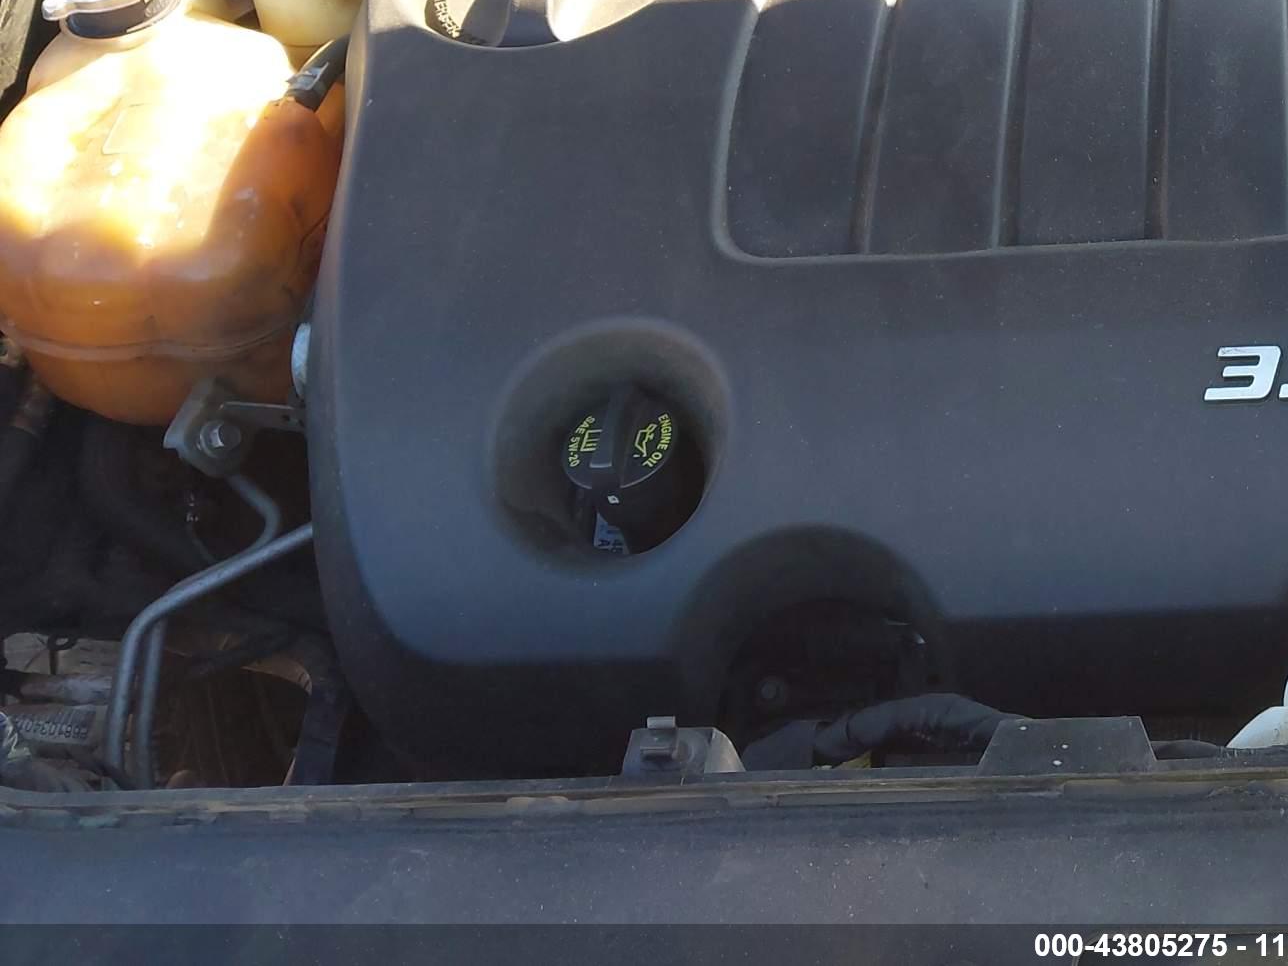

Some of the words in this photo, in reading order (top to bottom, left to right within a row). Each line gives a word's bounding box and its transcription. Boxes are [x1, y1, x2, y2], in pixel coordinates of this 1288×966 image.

[574, 415, 596, 435] SAE
[658, 413, 672, 450] ENGINE
[568, 436, 580, 467] 5W-20
[642, 451, 663, 468] OIL
